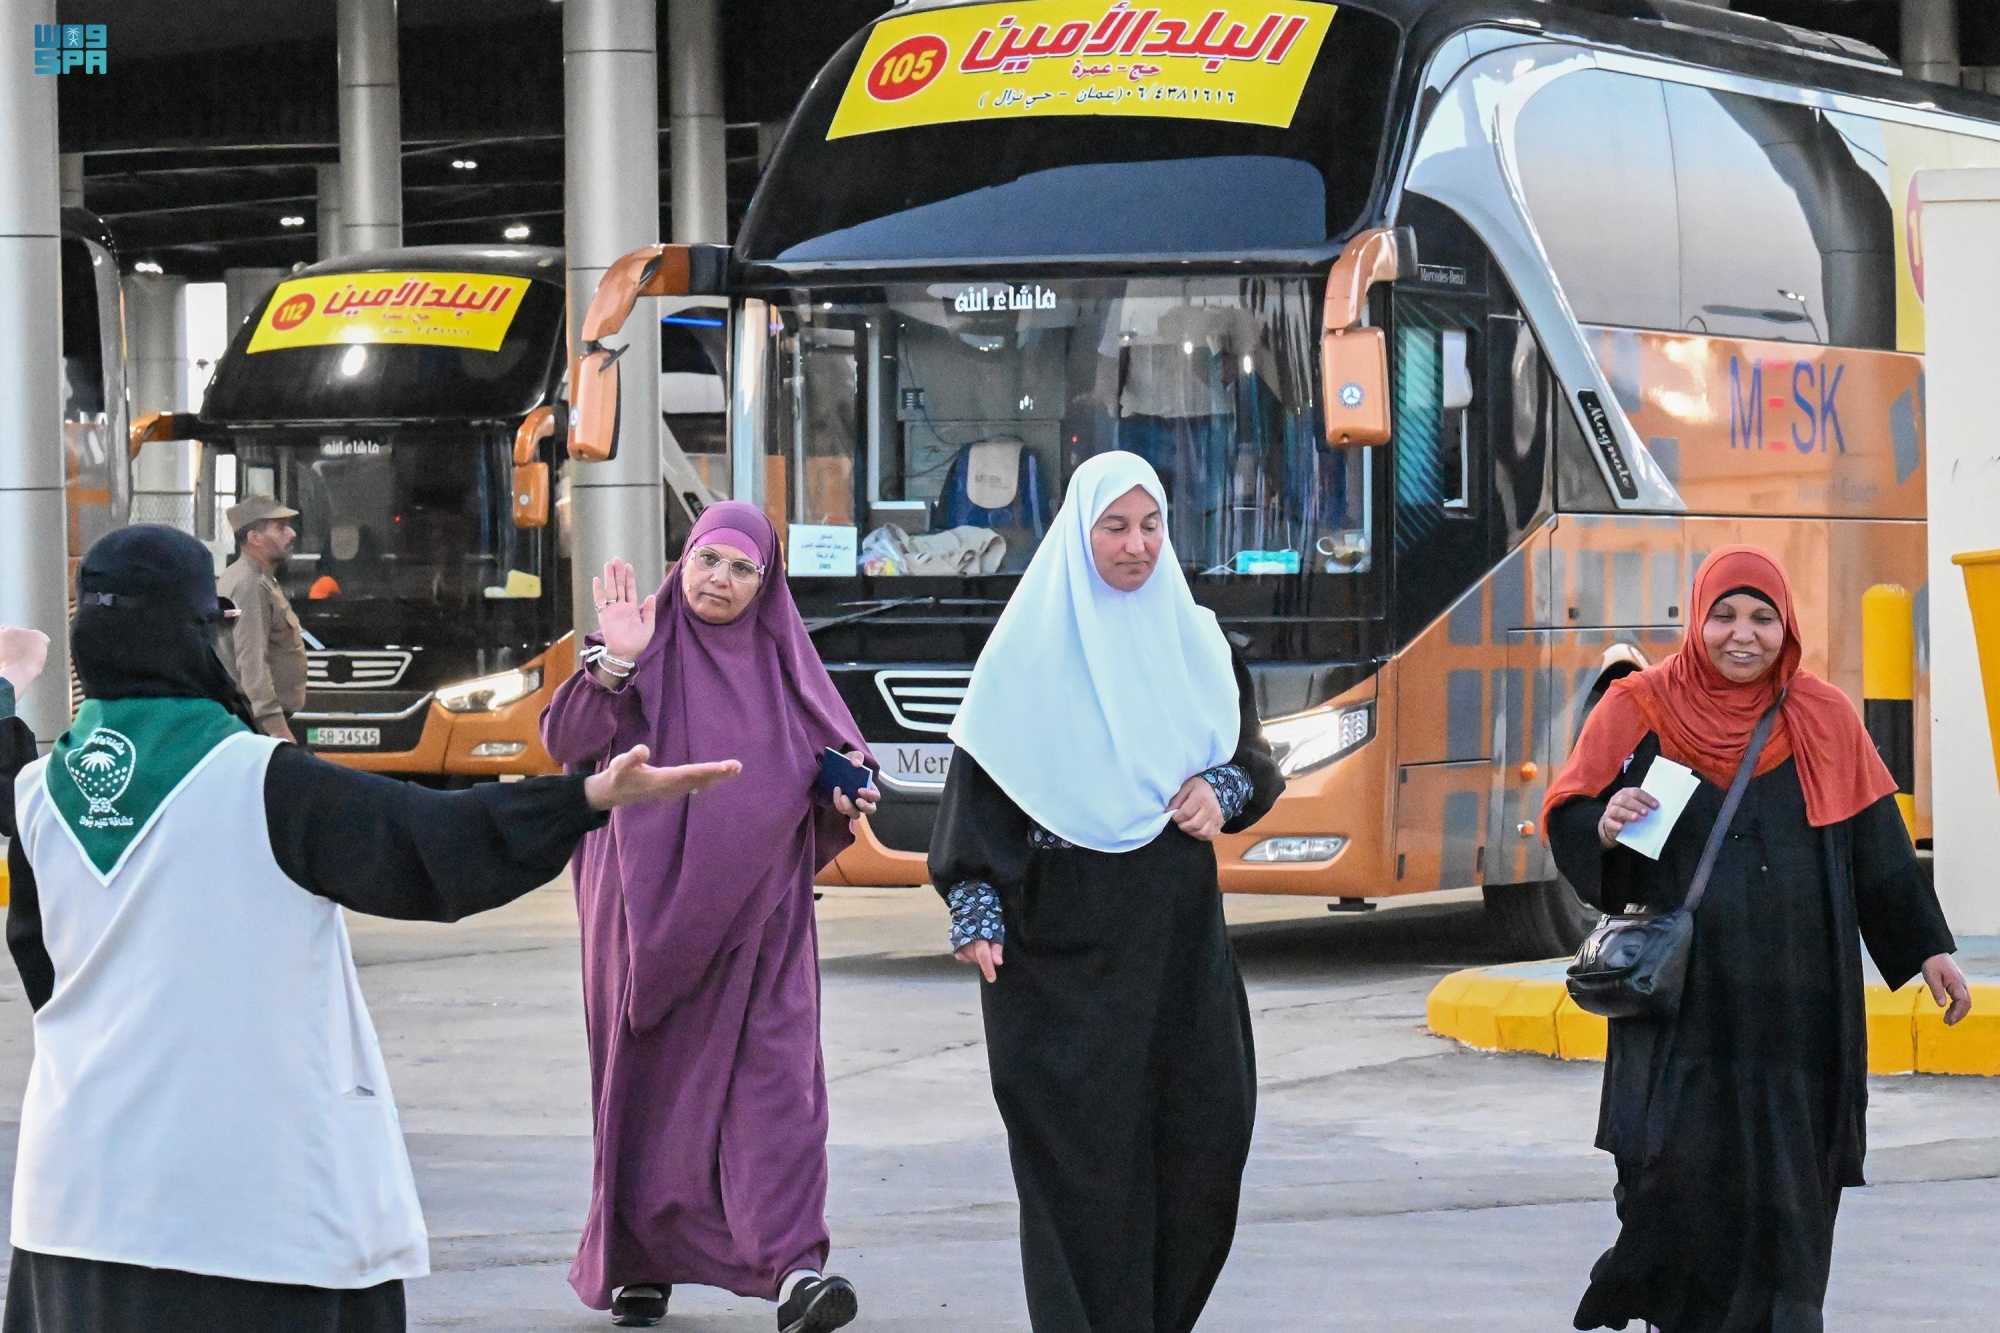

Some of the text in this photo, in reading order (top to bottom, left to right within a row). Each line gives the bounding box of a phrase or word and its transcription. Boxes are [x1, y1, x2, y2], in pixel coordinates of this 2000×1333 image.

[878, 48, 939, 87] 105
[1071, 60, 1161, 82] حج عمرة
[1026, 91, 1053, 108] حي
[279, 301, 308, 323] 112
[954, 286, 990, 313] الله
[1730, 355, 1846, 454] MESK
[897, 748, 949, 775] Mer
